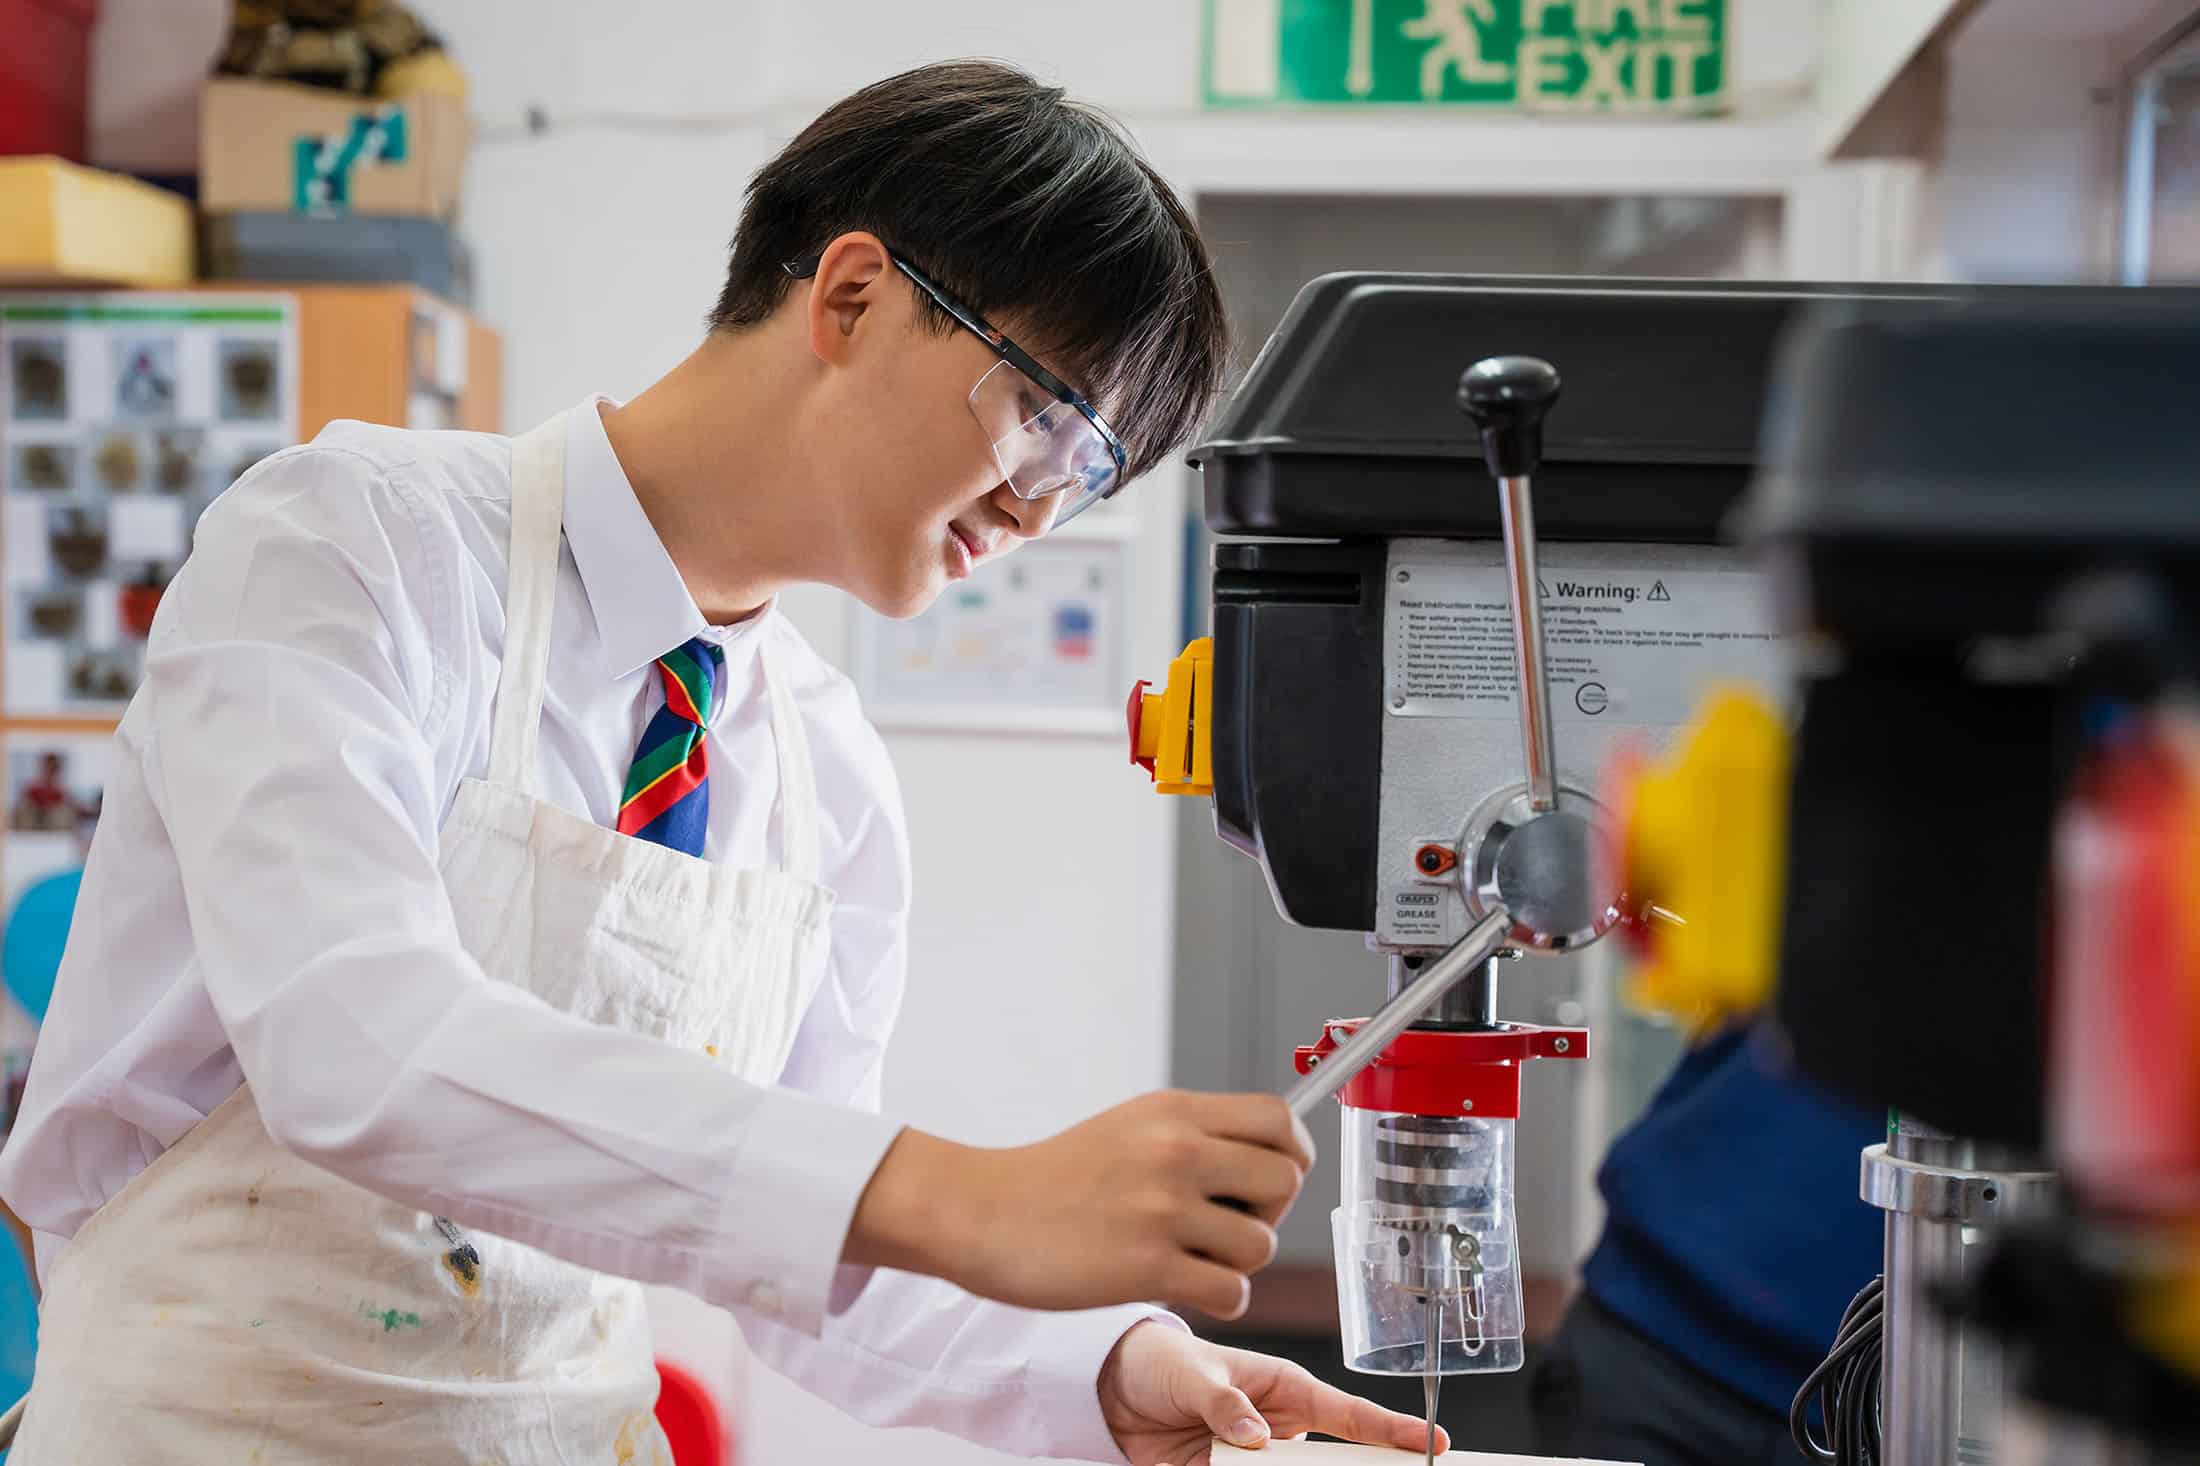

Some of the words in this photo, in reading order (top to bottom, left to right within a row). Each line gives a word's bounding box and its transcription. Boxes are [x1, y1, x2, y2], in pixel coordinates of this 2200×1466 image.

[1516, 38, 1713, 106] EXIT
[1556, 582, 1640, 603] Warning:
[1400, 600, 1423, 609] Read
[1424, 600, 1472, 610] instruction
[1396, 910, 1436, 919] GREASE
